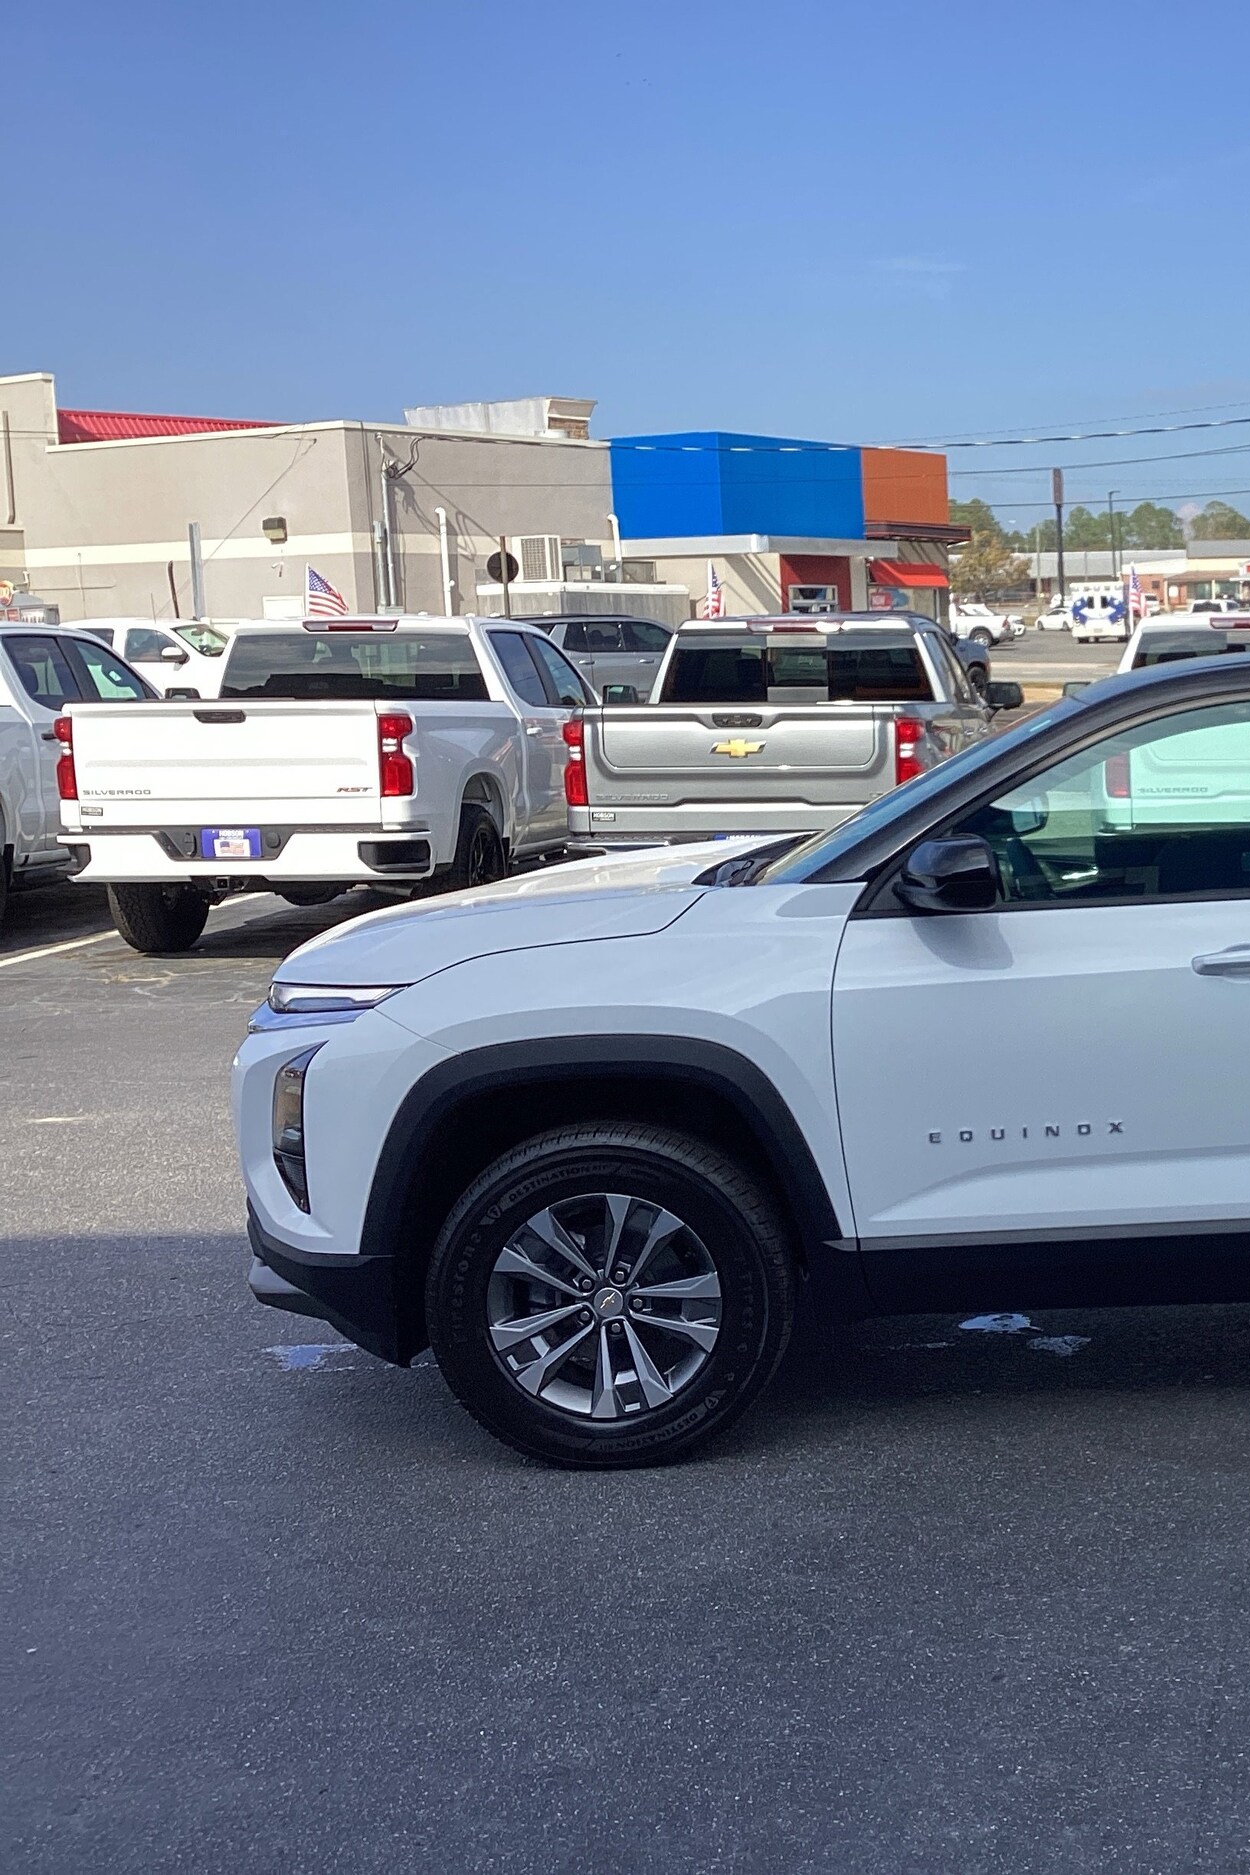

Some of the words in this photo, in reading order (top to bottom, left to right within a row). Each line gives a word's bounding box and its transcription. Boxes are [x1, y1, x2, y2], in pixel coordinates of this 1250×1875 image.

[82, 788, 152, 796] SILVERADO
[1137, 786, 1209, 794] SILVERADO
[595, 793, 669, 801] SILVERADO
[928, 1119, 1124, 1144] EQUINOX
